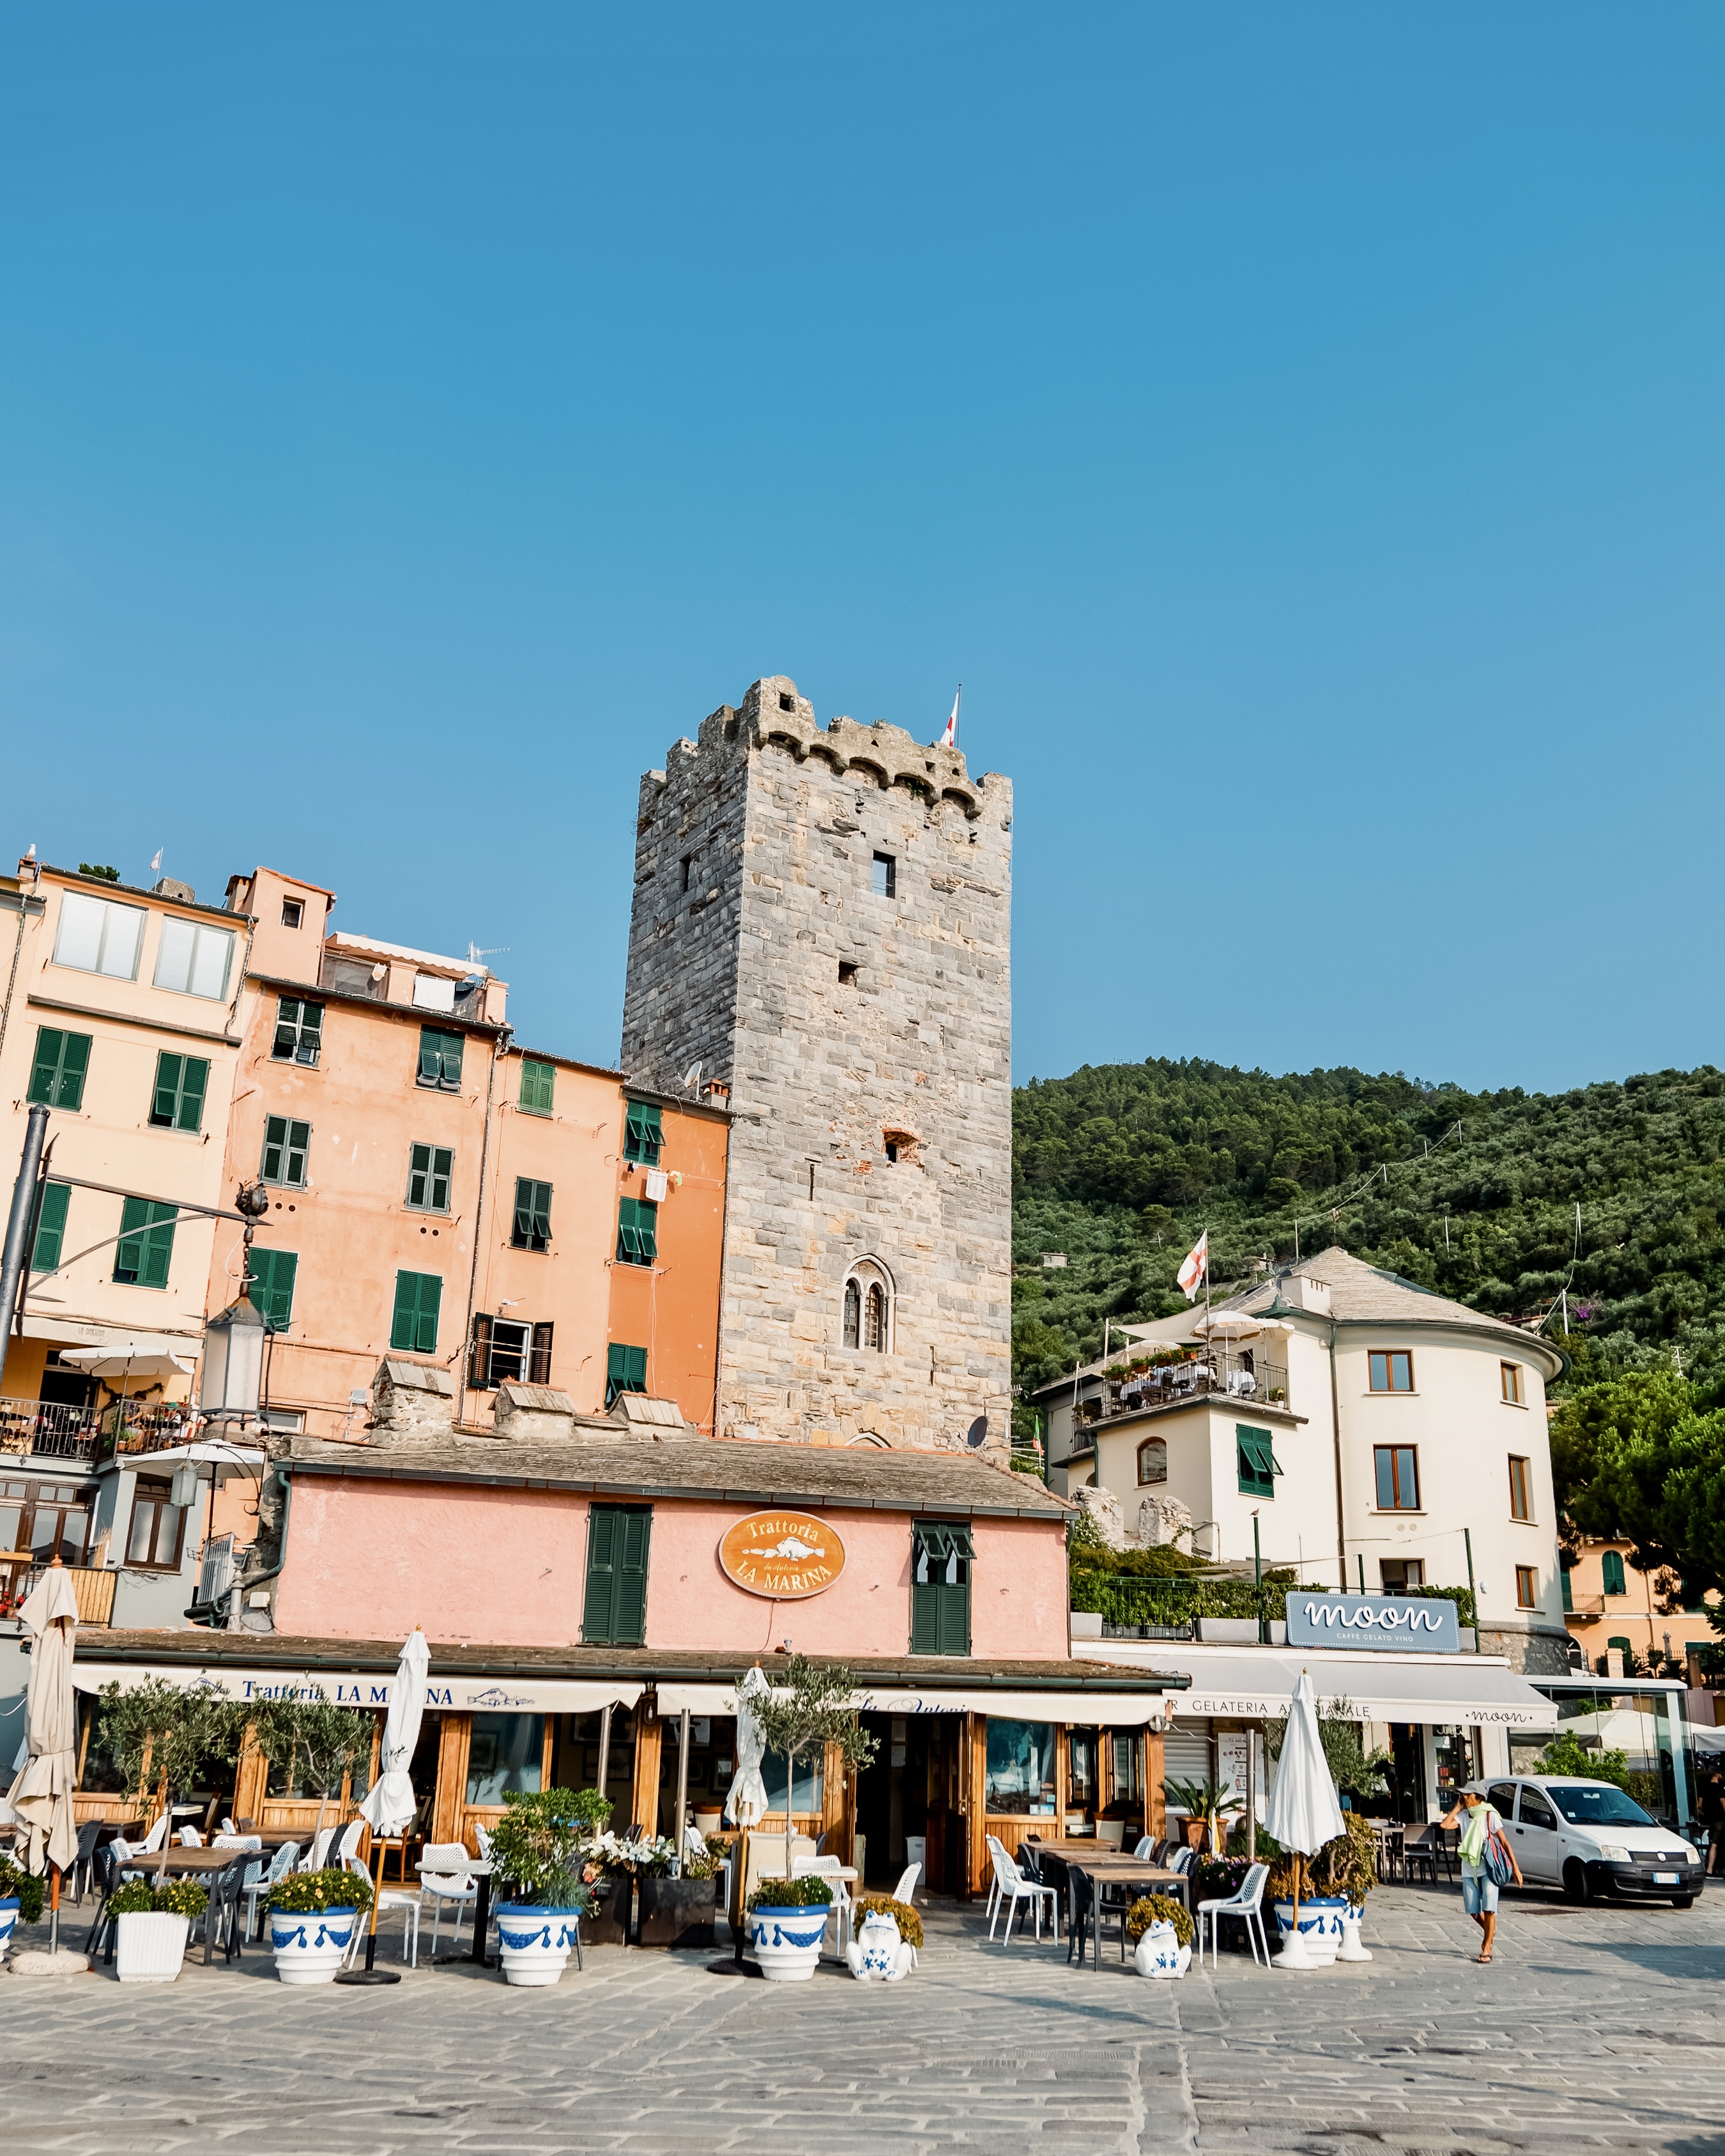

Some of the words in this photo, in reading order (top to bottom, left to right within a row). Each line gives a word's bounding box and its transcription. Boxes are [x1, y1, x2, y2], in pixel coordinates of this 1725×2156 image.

[747, 1520, 818, 1541] Trattoria
[735, 1560, 757, 1584] LA
[763, 1564, 833, 1591] MARINA
[763, 1562, 772, 1570] da
[772, 1563, 799, 1571] Antonio
[1304, 1602, 1443, 1631] moon
[336, 1685, 361, 1701] LA
[369, 1686, 453, 1705] MNA
[1192, 1700, 1268, 1713] GELATERIA
